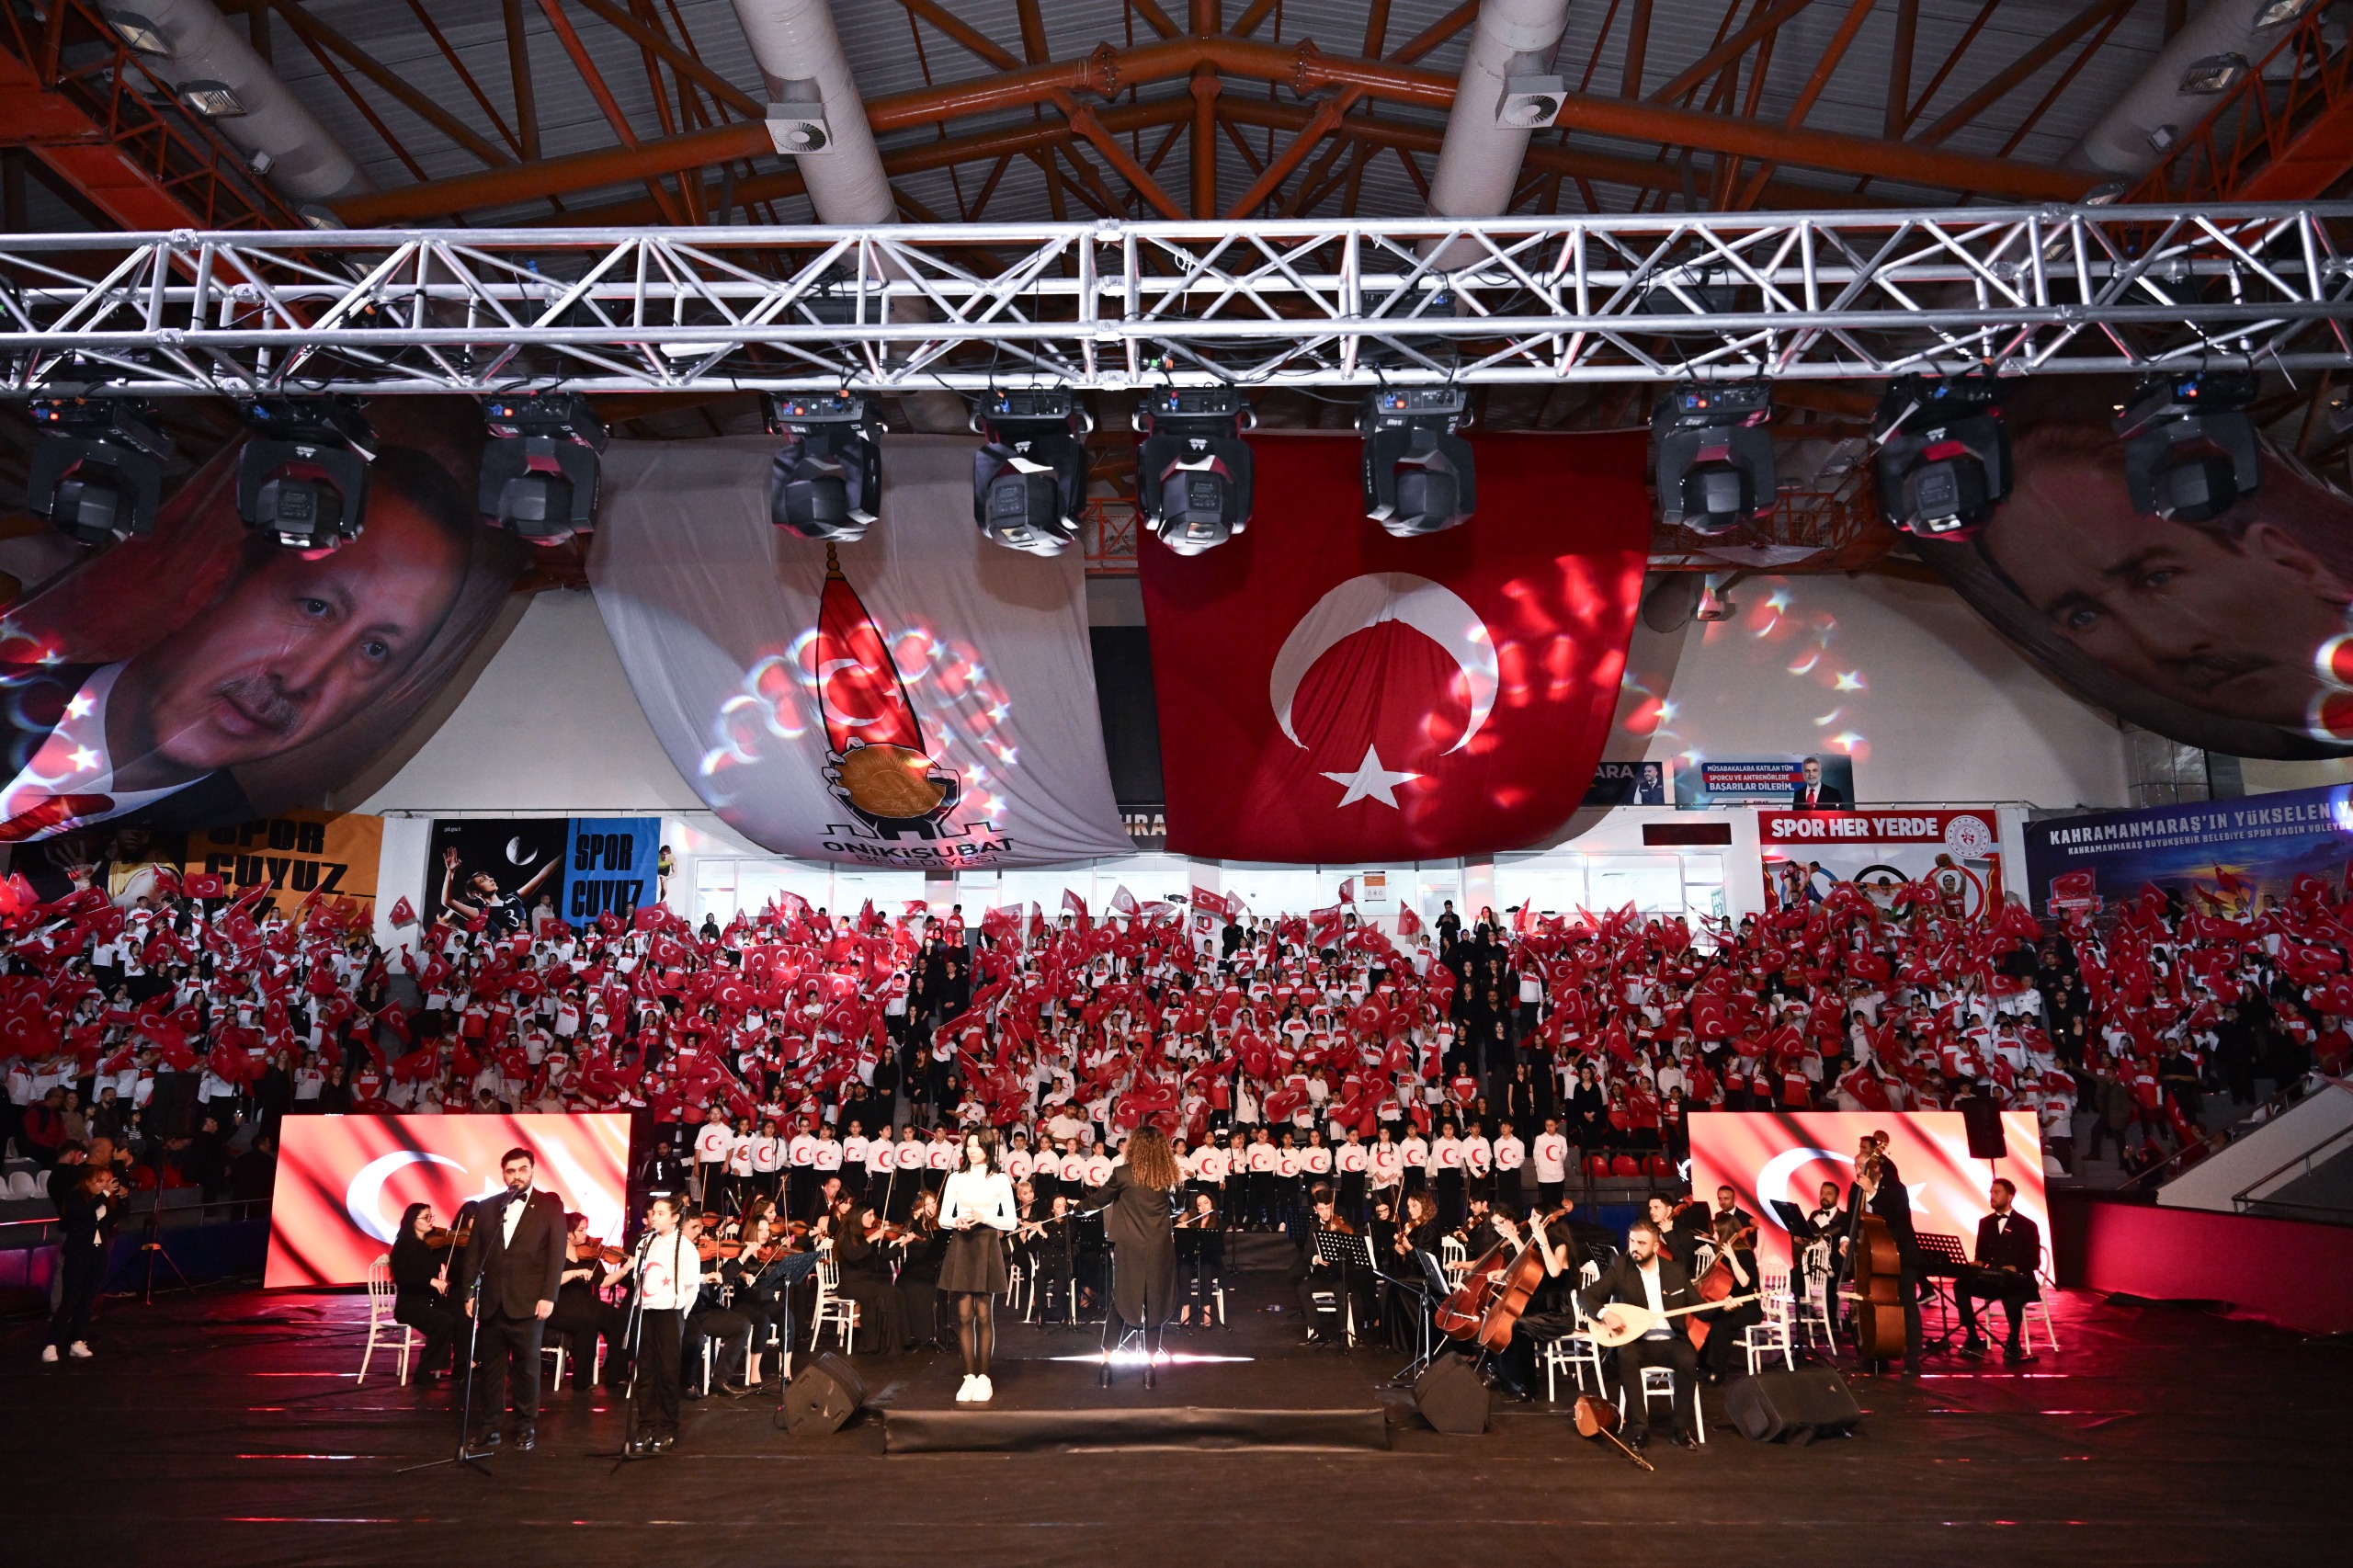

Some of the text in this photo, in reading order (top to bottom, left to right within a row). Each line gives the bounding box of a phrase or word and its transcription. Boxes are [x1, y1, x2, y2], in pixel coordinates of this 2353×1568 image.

[1710, 781, 1794, 791] BAŞARILAR DİLERİM.
[1771, 817, 1939, 838] SPOR HER YERDE
[2050, 813, 2227, 845] KAHRAMANMARAŞ'IN
[2234, 802, 2331, 826] YÜKSELEN
[574, 834, 633, 870] SPOR
[2068, 841, 2143, 855] KAHRAMANMARAŞ
[2145, 835, 2200, 848] BÜYÜKŞEHİR
[2203, 831, 2245, 843] BELEDİYE
[2248, 828, 2272, 838] SPOR
[2276, 825, 2305, 835] KADIN
